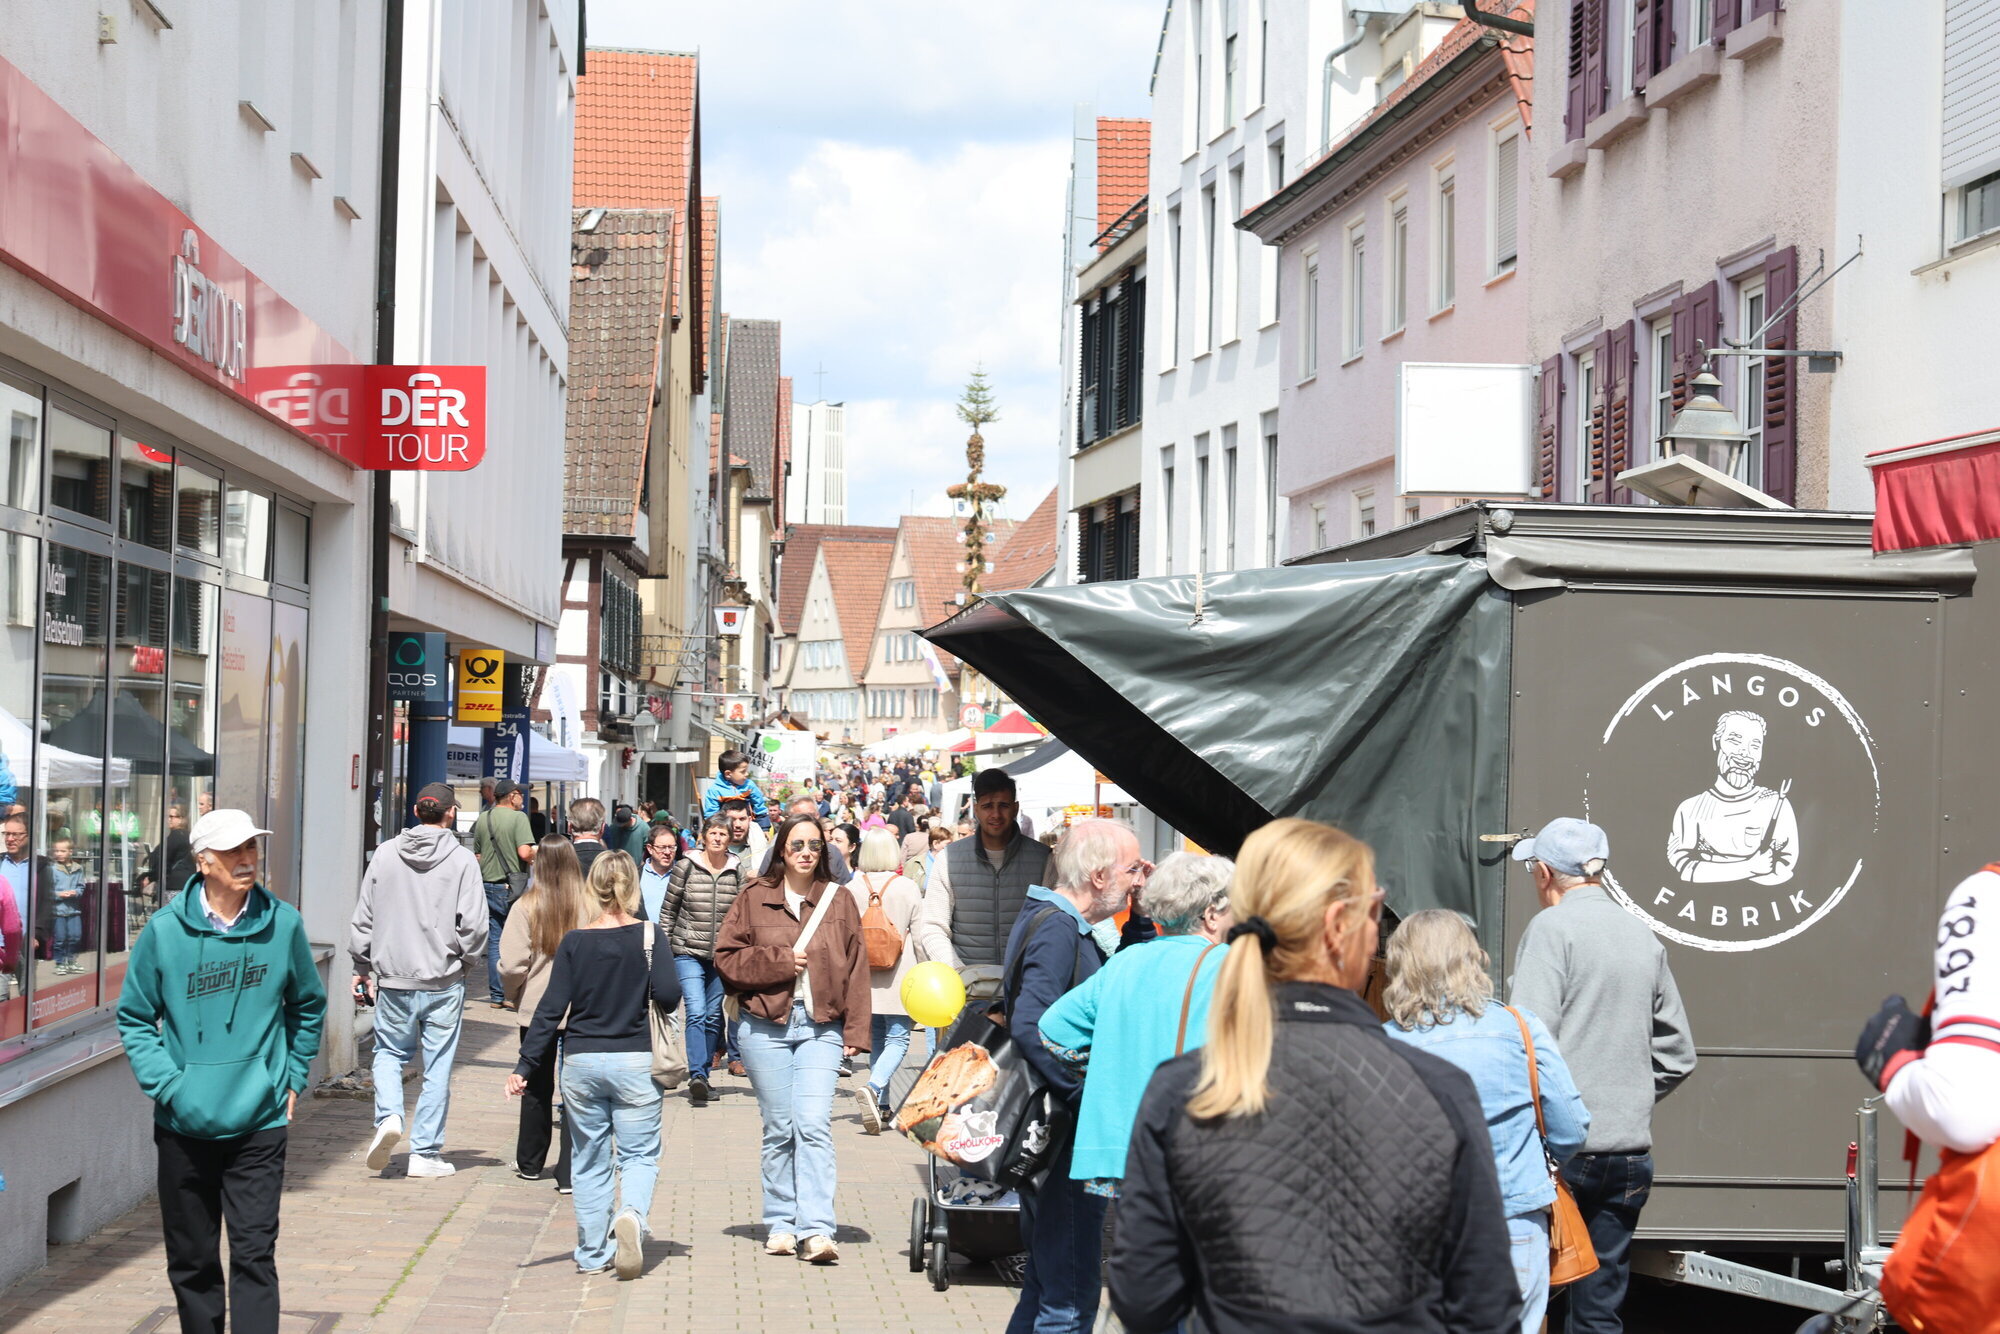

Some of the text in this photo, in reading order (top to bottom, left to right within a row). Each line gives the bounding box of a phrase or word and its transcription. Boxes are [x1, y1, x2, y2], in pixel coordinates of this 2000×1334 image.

[381, 388, 470, 428] DER
[381, 433, 470, 463] TOUR
[46, 562, 66, 596] Mein
[45, 611, 83, 647] Reisebüro
[387, 672, 437, 687] QOS
[392, 689, 428, 697] PARTNER
[1652, 673, 1827, 727] LÁNGOS
[496, 722, 518, 737] 54
[447, 751, 479, 762] EIDER
[748, 756, 774, 772] ASCH
[1653, 886, 1816, 928] FABRIK
